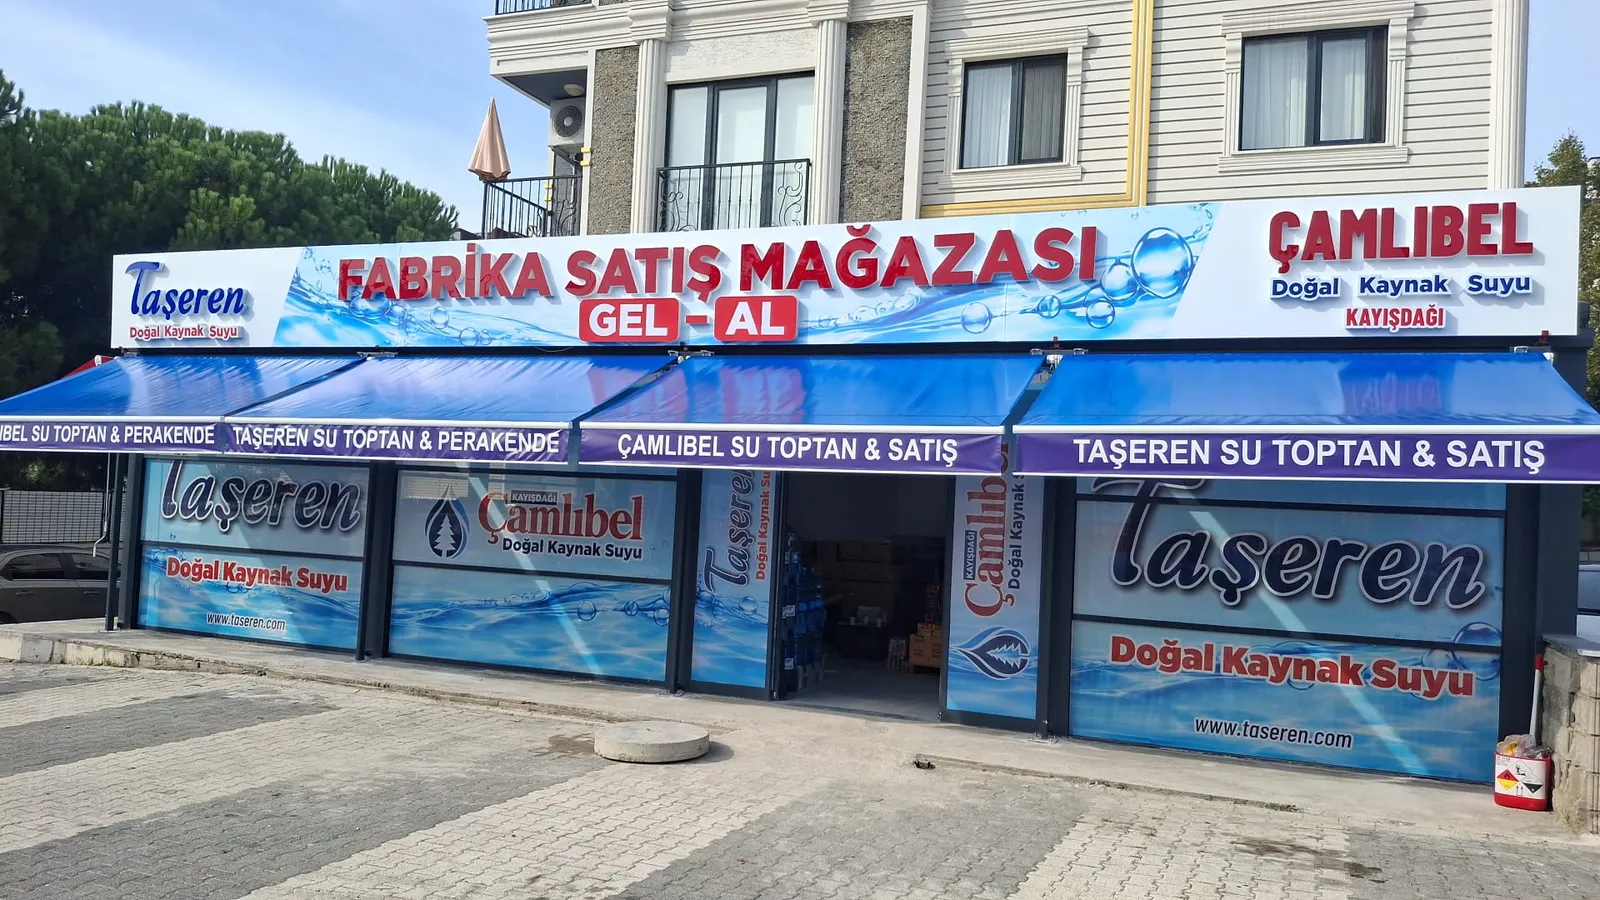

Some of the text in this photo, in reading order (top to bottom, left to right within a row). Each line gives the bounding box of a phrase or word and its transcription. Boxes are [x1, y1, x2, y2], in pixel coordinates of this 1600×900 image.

[1269, 202, 1534, 274] ÇAMLIBEL
[337, 224, 1097, 302] FABRİKA SATIŞ MAĞAZASI
[125, 261, 245, 320] Taşeren
[1271, 274, 1530, 298] Doğal Kaynak Suyu
[129, 325, 238, 340] Doğal Kaynak Suyu
[588, 303, 668, 337] GEL
[725, 301, 785, 336] AL
[1345, 305, 1444, 330] KAYIŞDAĞI
[31, 425, 50, 442] SU
[54, 425, 106, 443] TOPTAN
[110, 425, 120, 443] &
[124, 426, 215, 444] PERAKENDE
[233, 426, 560, 453] TAŞEREN SU TOPTAN & PERAKENDE
[618, 434, 958, 467] ÇAMLIBEL SU TOPTAN & SATIŞ
[1073, 439, 1545, 475] TAŞEREN SU TOPTAN & SATIŞ
[512, 491, 557, 504] KAYIŞDAĞI
[757, 490, 772, 539] Kaynak
[1009, 483, 1026, 542] Kaynak
[478, 491, 643, 544] Çamlıbel
[964, 442, 1015, 617] Çamlıb
[503, 538, 643, 560] Doğal Kaynak Suyu
[756, 541, 769, 580] Doğal
[964, 531, 976, 579] KAYIŞDAĞI
[1008, 540, 1024, 590] Doğal
[167, 557, 348, 594] Doğal Kaynak Suyu
[207, 612, 286, 632] www.taseren.com
[1111, 635, 1474, 699] Doğal Kaynak Suyu
[1194, 717, 1353, 749] www.taseren.com
